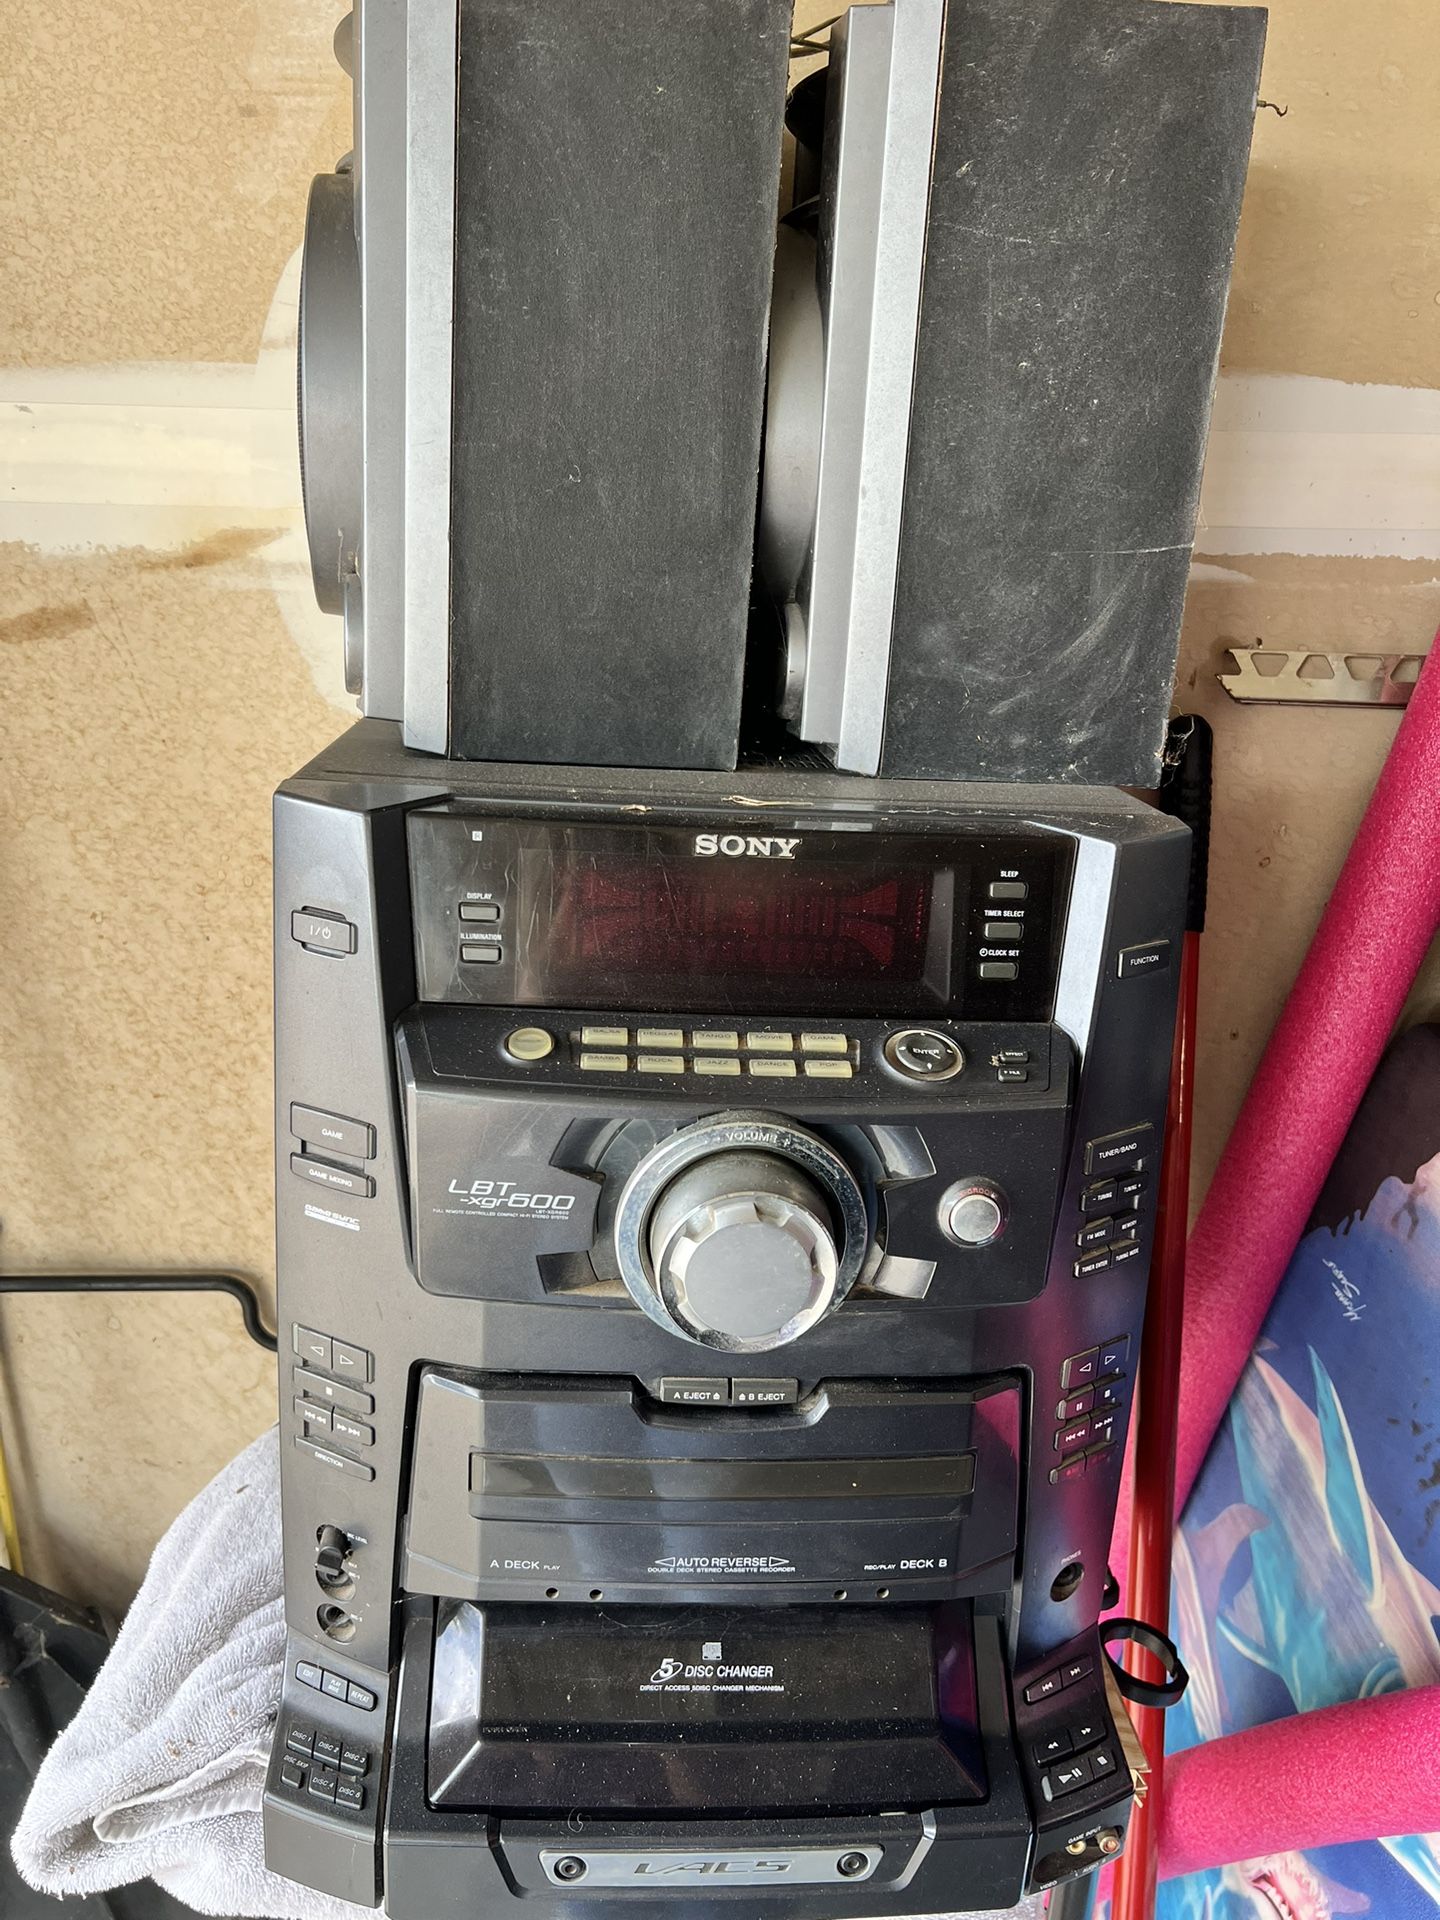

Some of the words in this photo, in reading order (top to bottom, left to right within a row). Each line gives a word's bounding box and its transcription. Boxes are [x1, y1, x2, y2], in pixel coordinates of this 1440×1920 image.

[696, 834, 801, 858] SONY
[460, 932, 502, 940] ILLUMINATION
[1130, 954, 1159, 966] FUNCTION
[322, 1128, 343, 1140] GAME
[1098, 1142, 1138, 1159] TUNER/BAND
[309, 1168, 328, 1180] GAME
[329, 1174, 352, 1187] MIXING
[448, 1179, 517, 1196] LBT
[1124, 1184, 1137, 1193] TUNING
[1098, 1192, 1112, 1200] TUNING
[1095, 1230, 1106, 1238] MODE
[1116, 1252, 1128, 1261] TUNING
[1082, 1264, 1094, 1272] TUNER
[1096, 1260, 1108, 1269] ENTER
[314, 1452, 344, 1468] DIRECTION
[490, 1560, 499, 1568] A
[504, 1560, 540, 1570] DECK
[676, 1557, 709, 1567] AUTO
[711, 1557, 768, 1566] REVERSE
[900, 1559, 934, 1569] DECK
[938, 1558, 947, 1567] B
[303, 1668, 313, 1677] EDIT
[660, 1658, 674, 1678] 5
[685, 1665, 714, 1677] DISC
[717, 1665, 774, 1677] CHANGER
[352, 1690, 370, 1702] REPEAT
[292, 1730, 308, 1741] DISC
[318, 1741, 332, 1751] DISC
[284, 1754, 297, 1764] DISC
[344, 1751, 359, 1761] DISC
[312, 1776, 328, 1786] DISC
[339, 1786, 354, 1796] DISC
[1068, 1834, 1084, 1844] GAME
[1085, 1826, 1101, 1837] INPUT
[1040, 1880, 1058, 1890] VIDEO
